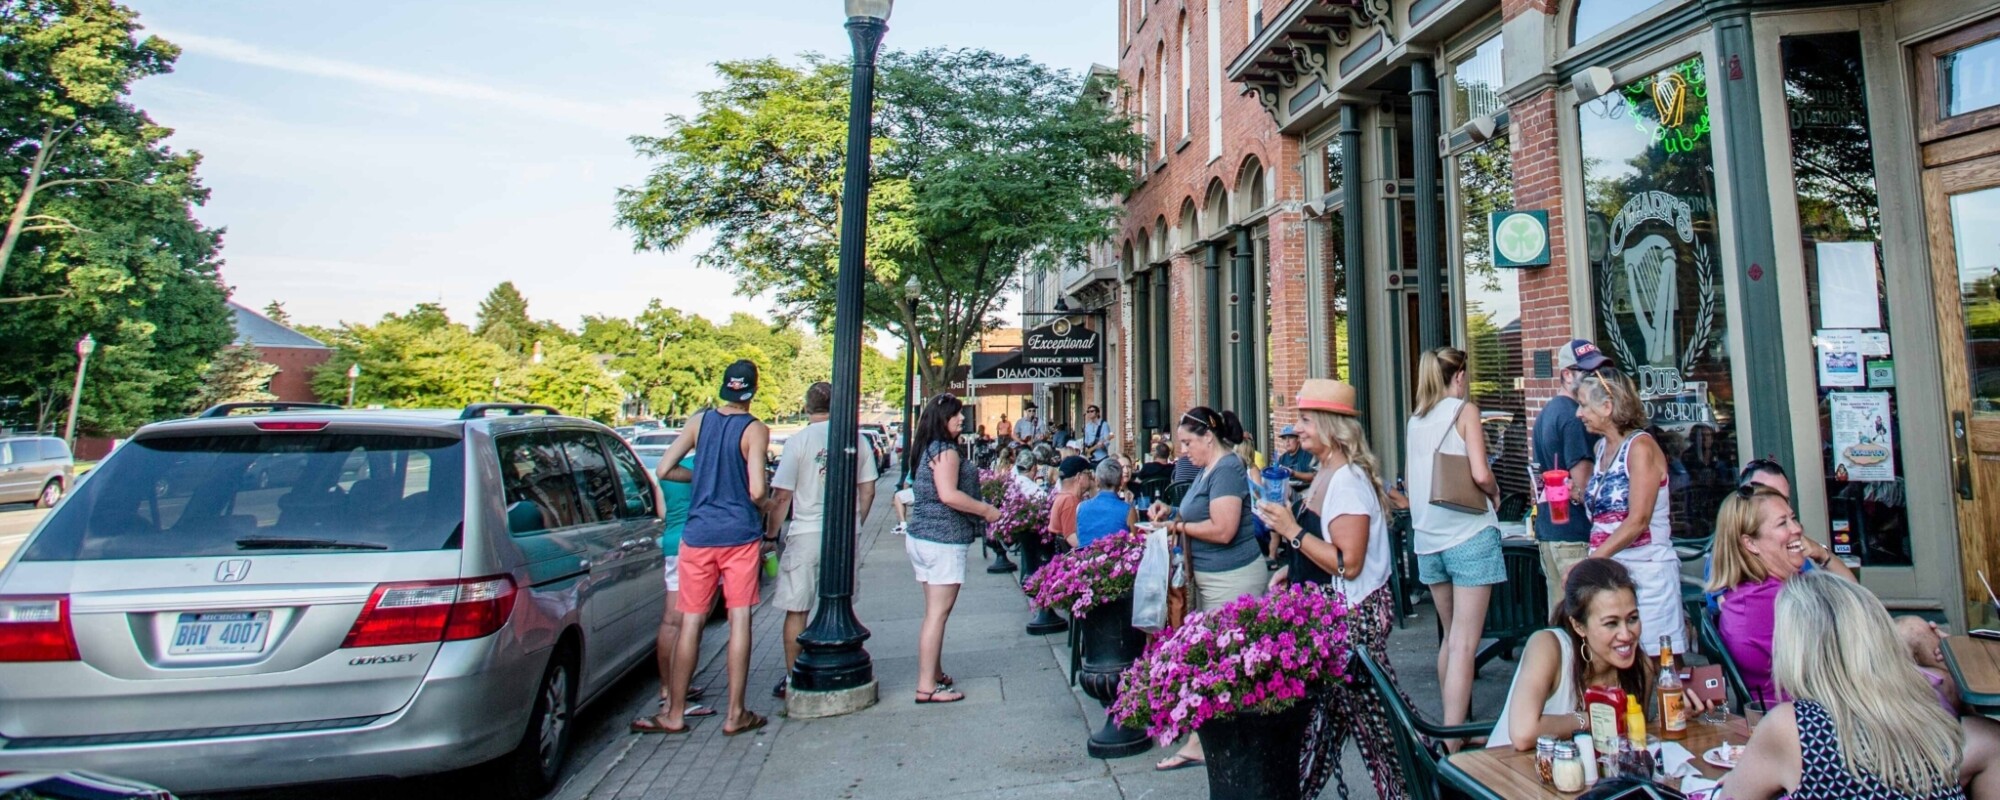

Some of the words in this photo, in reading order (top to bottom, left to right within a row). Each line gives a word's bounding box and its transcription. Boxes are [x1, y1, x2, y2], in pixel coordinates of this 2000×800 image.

[1609, 190, 1694, 257] CLEARY'S
[1028, 333, 1096, 355] Exceptional
[997, 367, 1063, 379] DIAMONDS
[1638, 365, 1683, 396] PUB
[200, 613, 248, 621] MICHIGAN
[176, 623, 212, 646] BHV
[219, 622, 264, 644] 4007
[348, 652, 419, 666] ODYSSEY
